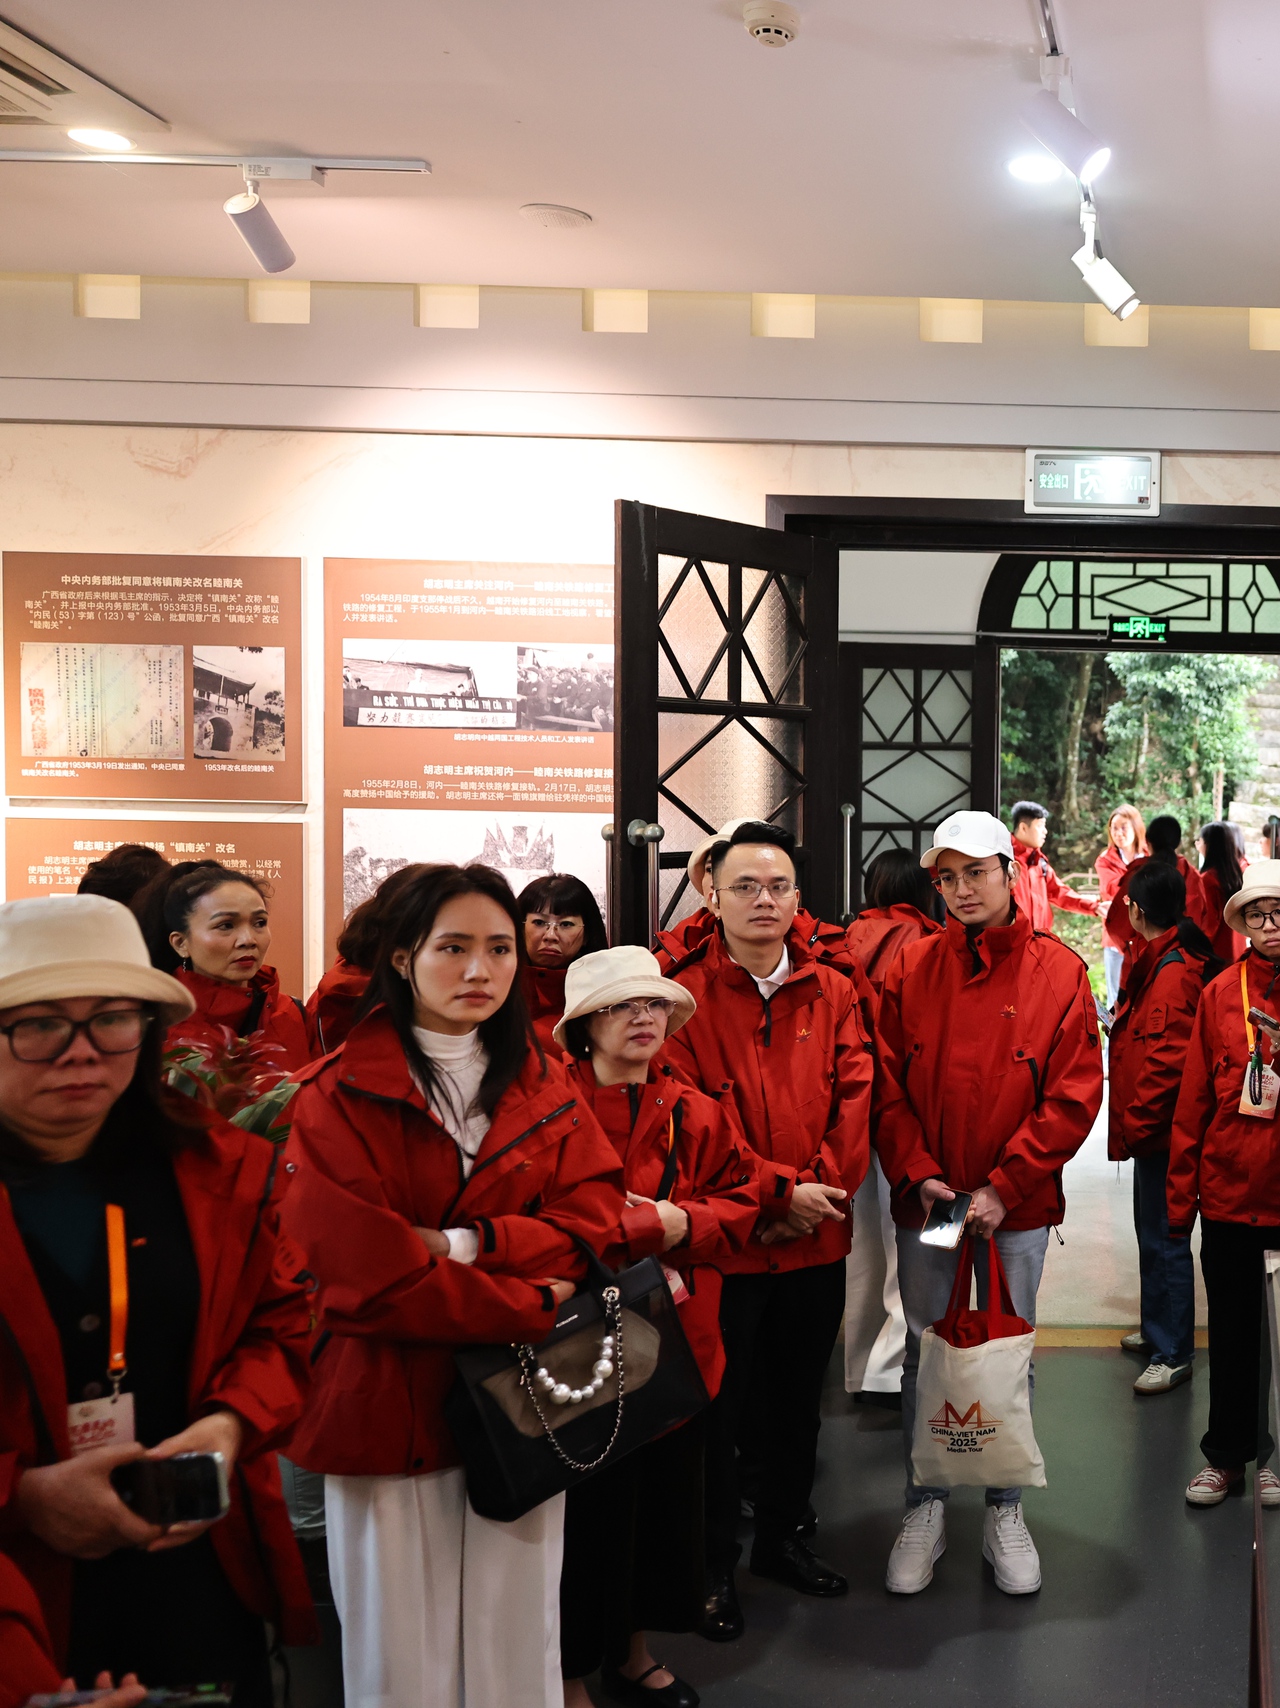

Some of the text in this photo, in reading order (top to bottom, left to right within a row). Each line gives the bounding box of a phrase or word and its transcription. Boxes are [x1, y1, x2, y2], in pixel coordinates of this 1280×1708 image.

[1039, 473, 1069, 489] 安全出口
[61, 575, 244, 589] 中央内务部批复同意将镇南关改名睦南关
[343, 613, 398, 623] 人并发表讲话。
[204, 763, 275, 773] 1953年改名后的睦南关
[343, 789, 614, 803] 高度赞扬中国给予的援助。胡志明主席还将一面锦旗赠给驻凭祥的中国铁
[931, 1427, 996, 1437] CHINA-VIET NAM
[950, 1438, 977, 1446] 2025
